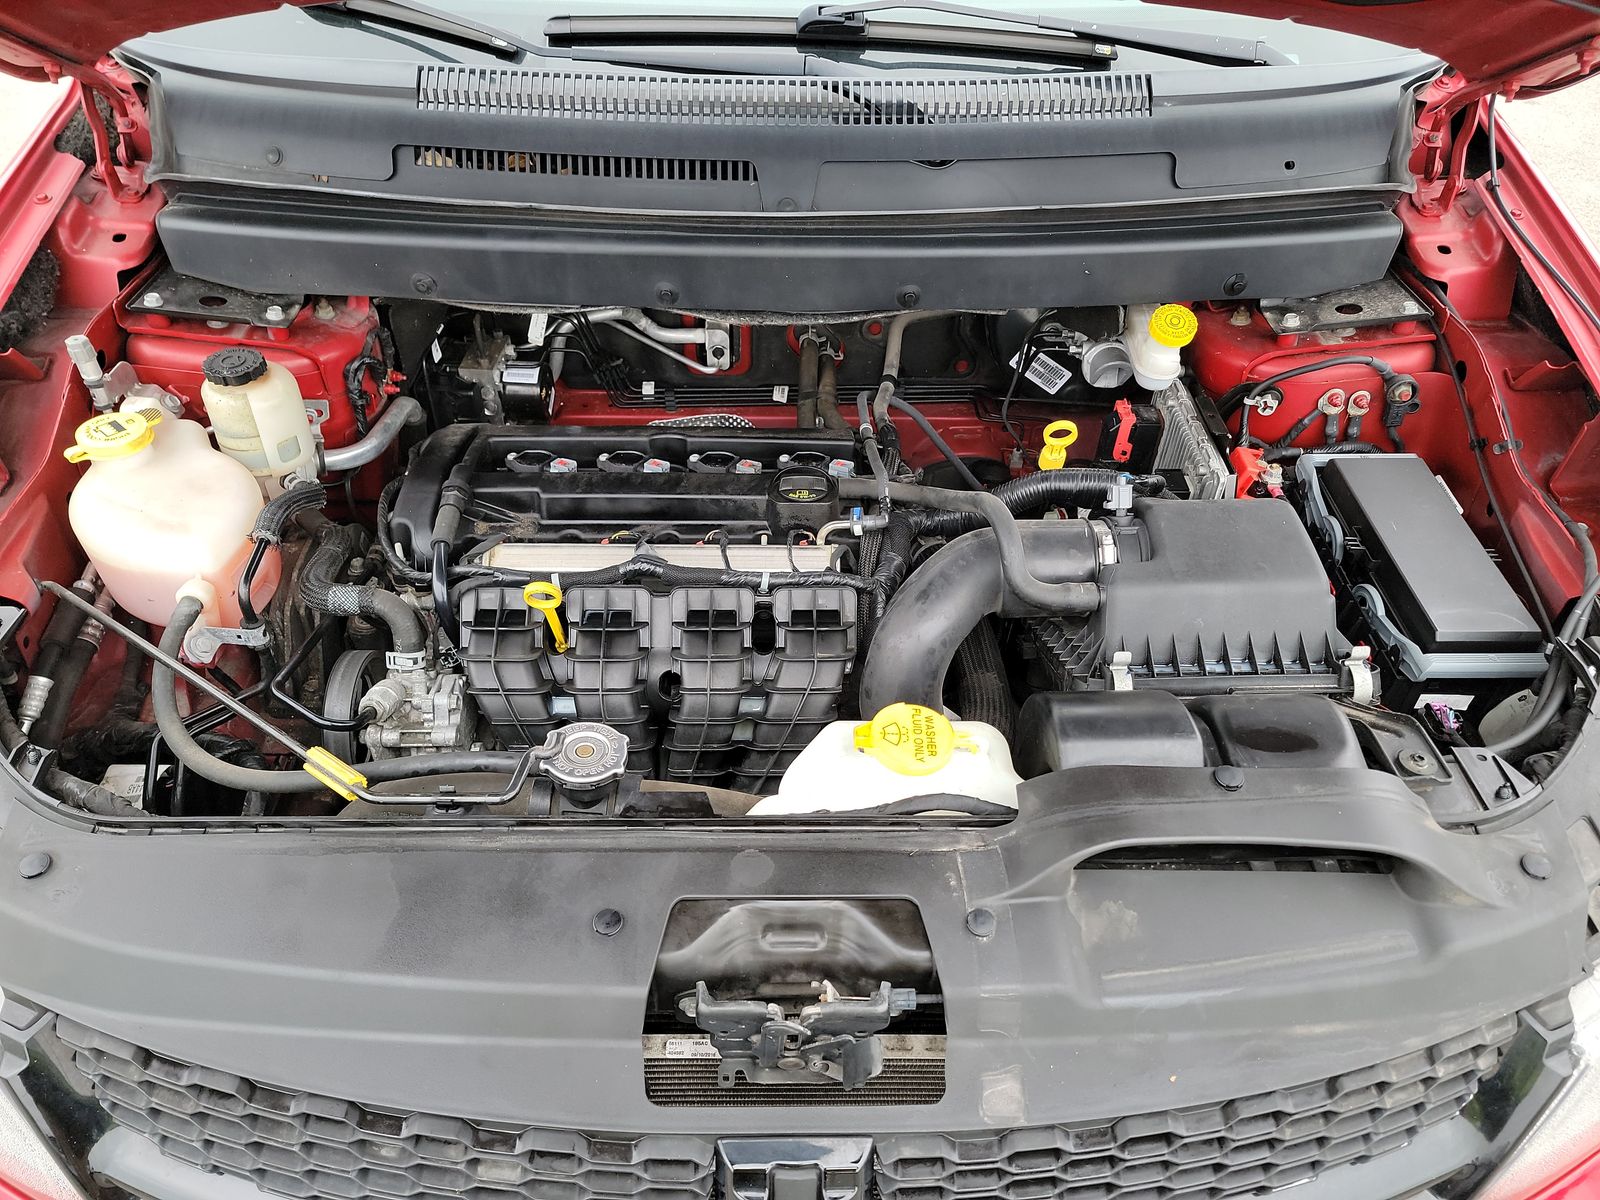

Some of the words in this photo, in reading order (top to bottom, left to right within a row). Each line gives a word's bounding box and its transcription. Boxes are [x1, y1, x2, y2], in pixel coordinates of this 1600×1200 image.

[911, 708, 923, 735] FLUID
[924, 715, 937, 757] WASHER
[913, 738, 926, 763] ONLY
[574, 765, 605, 776] OPEN
